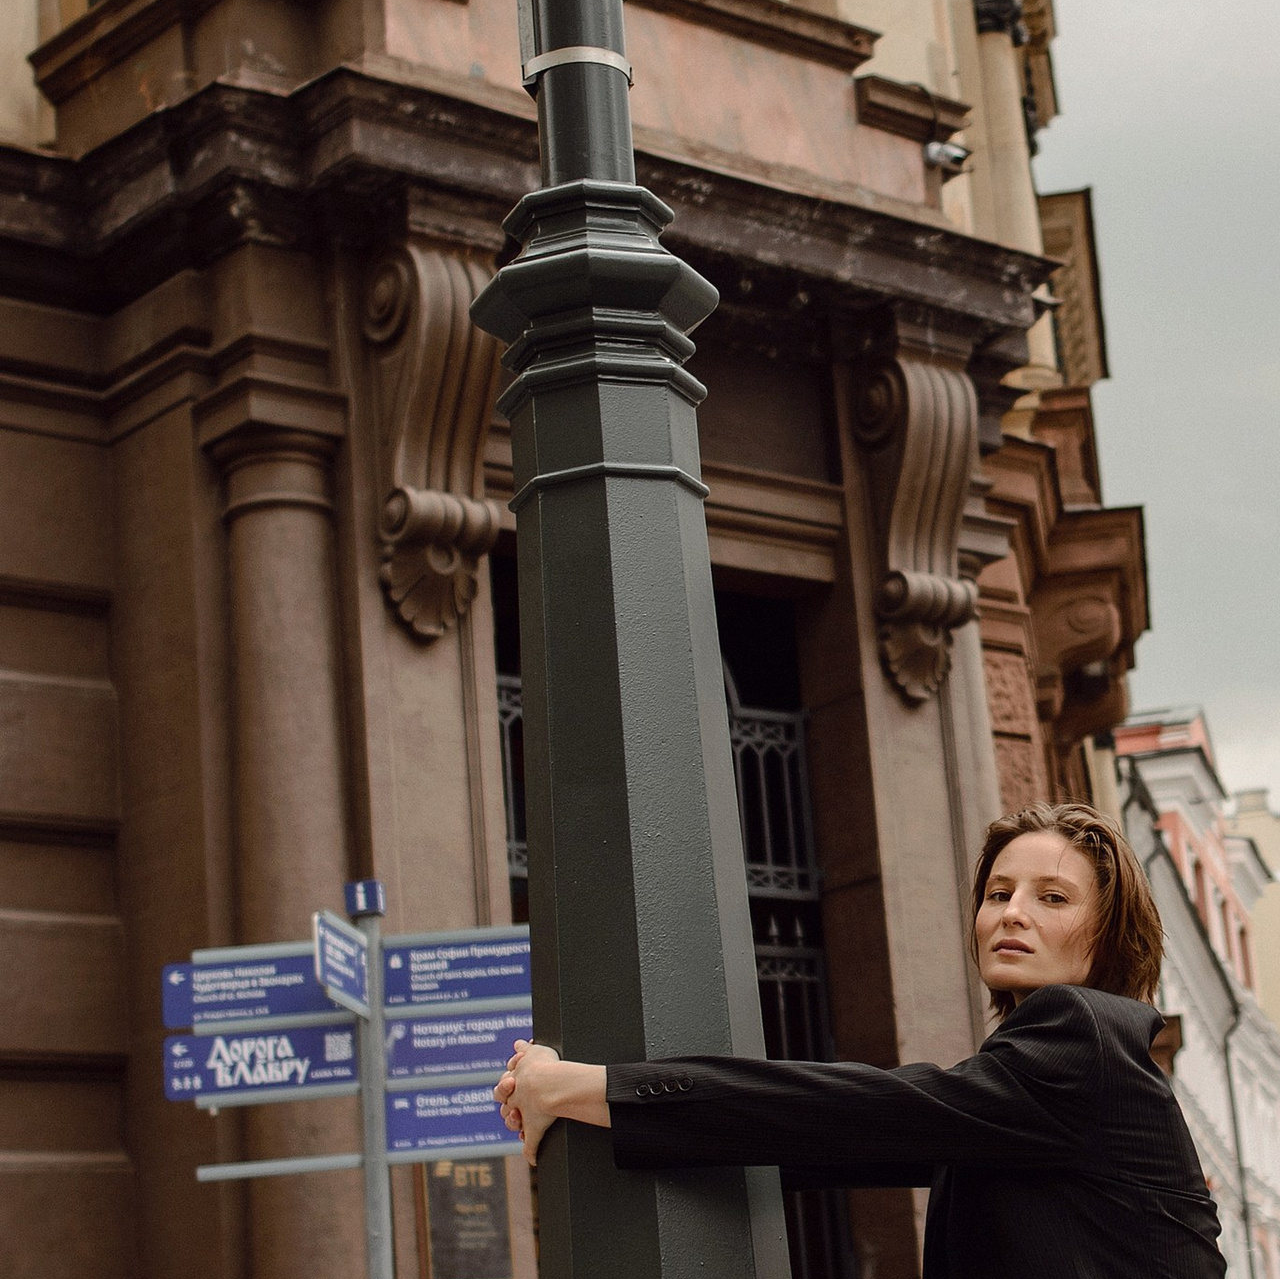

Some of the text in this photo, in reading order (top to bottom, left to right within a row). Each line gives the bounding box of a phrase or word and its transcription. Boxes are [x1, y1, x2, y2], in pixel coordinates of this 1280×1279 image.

[413, 1022, 466, 1035] Нотариус
[467, 1019, 504, 1031] города
[413, 1033, 496, 1049] Notary in Moscow
[416, 1094, 450, 1108] Отель
[416, 1103, 496, 1118] Hotel Savoy Moscow
